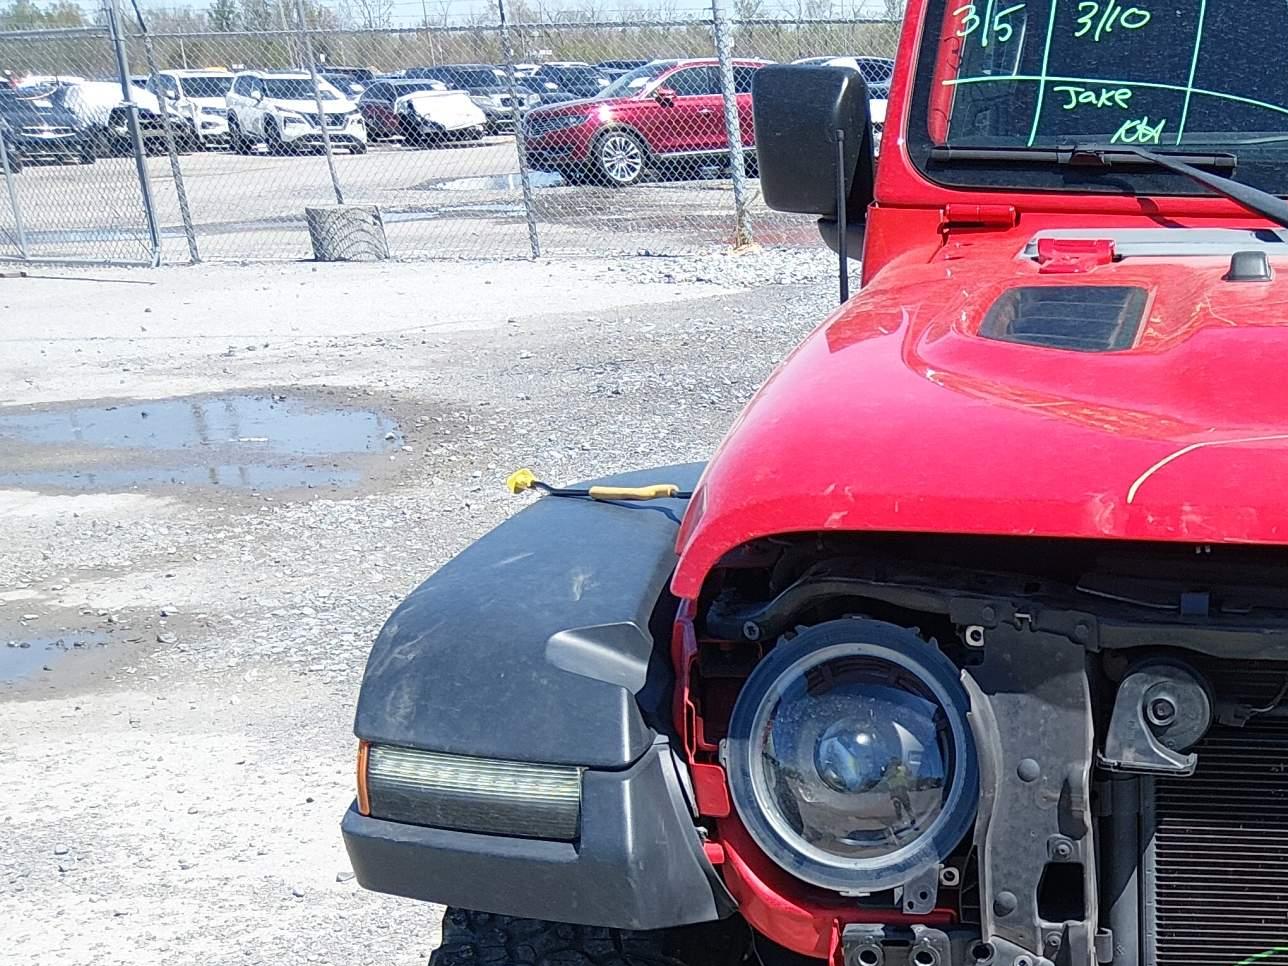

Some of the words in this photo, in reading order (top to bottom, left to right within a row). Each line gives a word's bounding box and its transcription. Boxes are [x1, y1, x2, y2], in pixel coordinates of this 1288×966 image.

[952, 0, 1027, 47] 3/5
[1074, 0, 1151, 42] 3/10
[1053, 85, 1133, 110] Jake
